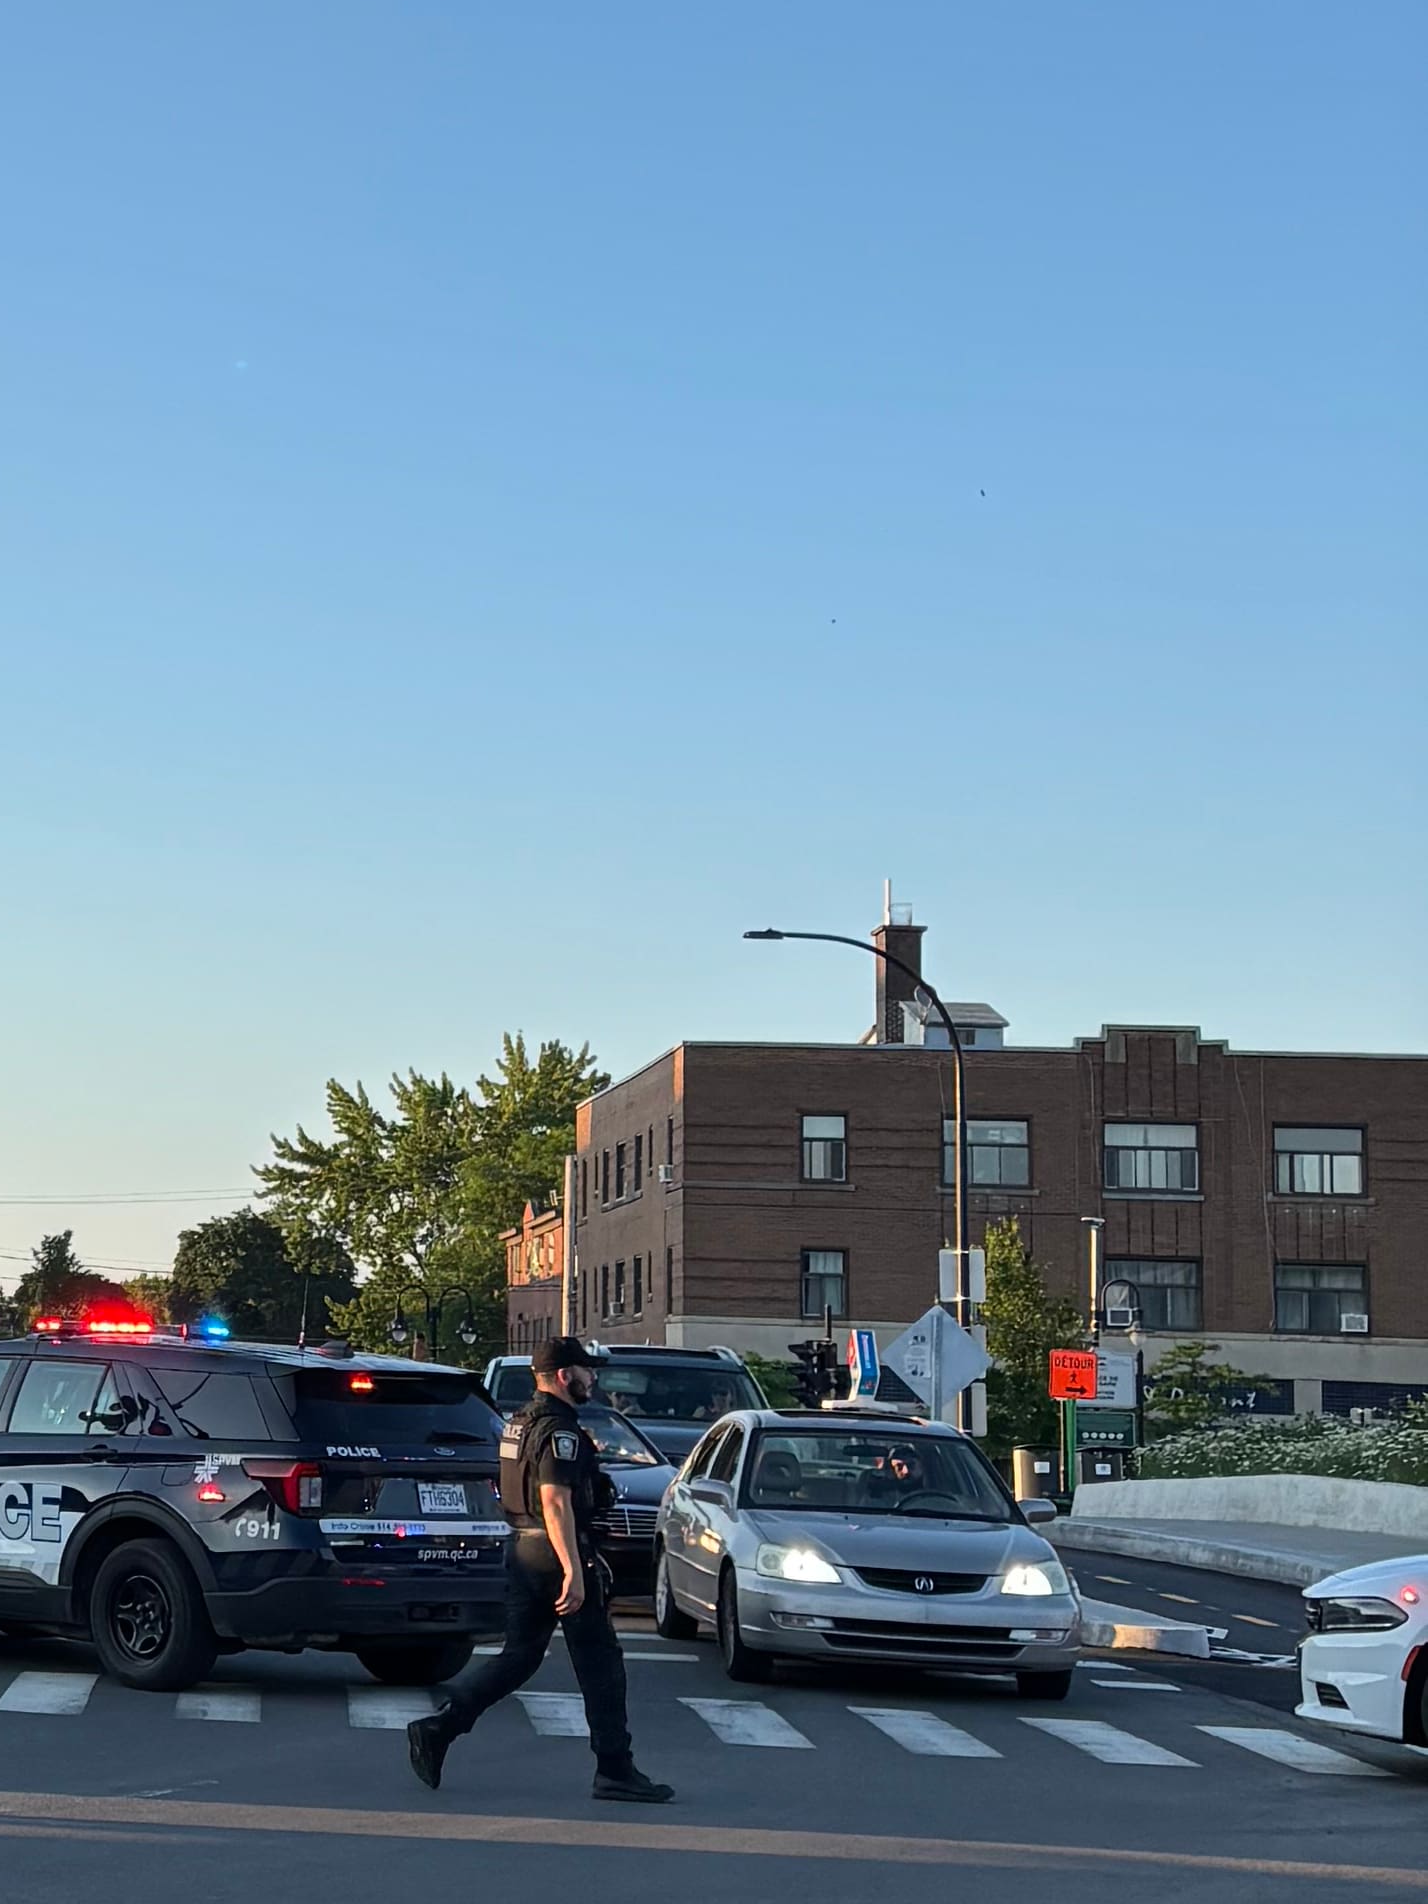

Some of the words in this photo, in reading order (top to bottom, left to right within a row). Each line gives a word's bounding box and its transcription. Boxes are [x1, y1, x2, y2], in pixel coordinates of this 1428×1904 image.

[326, 1445, 382, 1458] POLICE
[247, 1520, 281, 1540] 911
[417, 1549, 479, 1561] spvm.qc.ca
